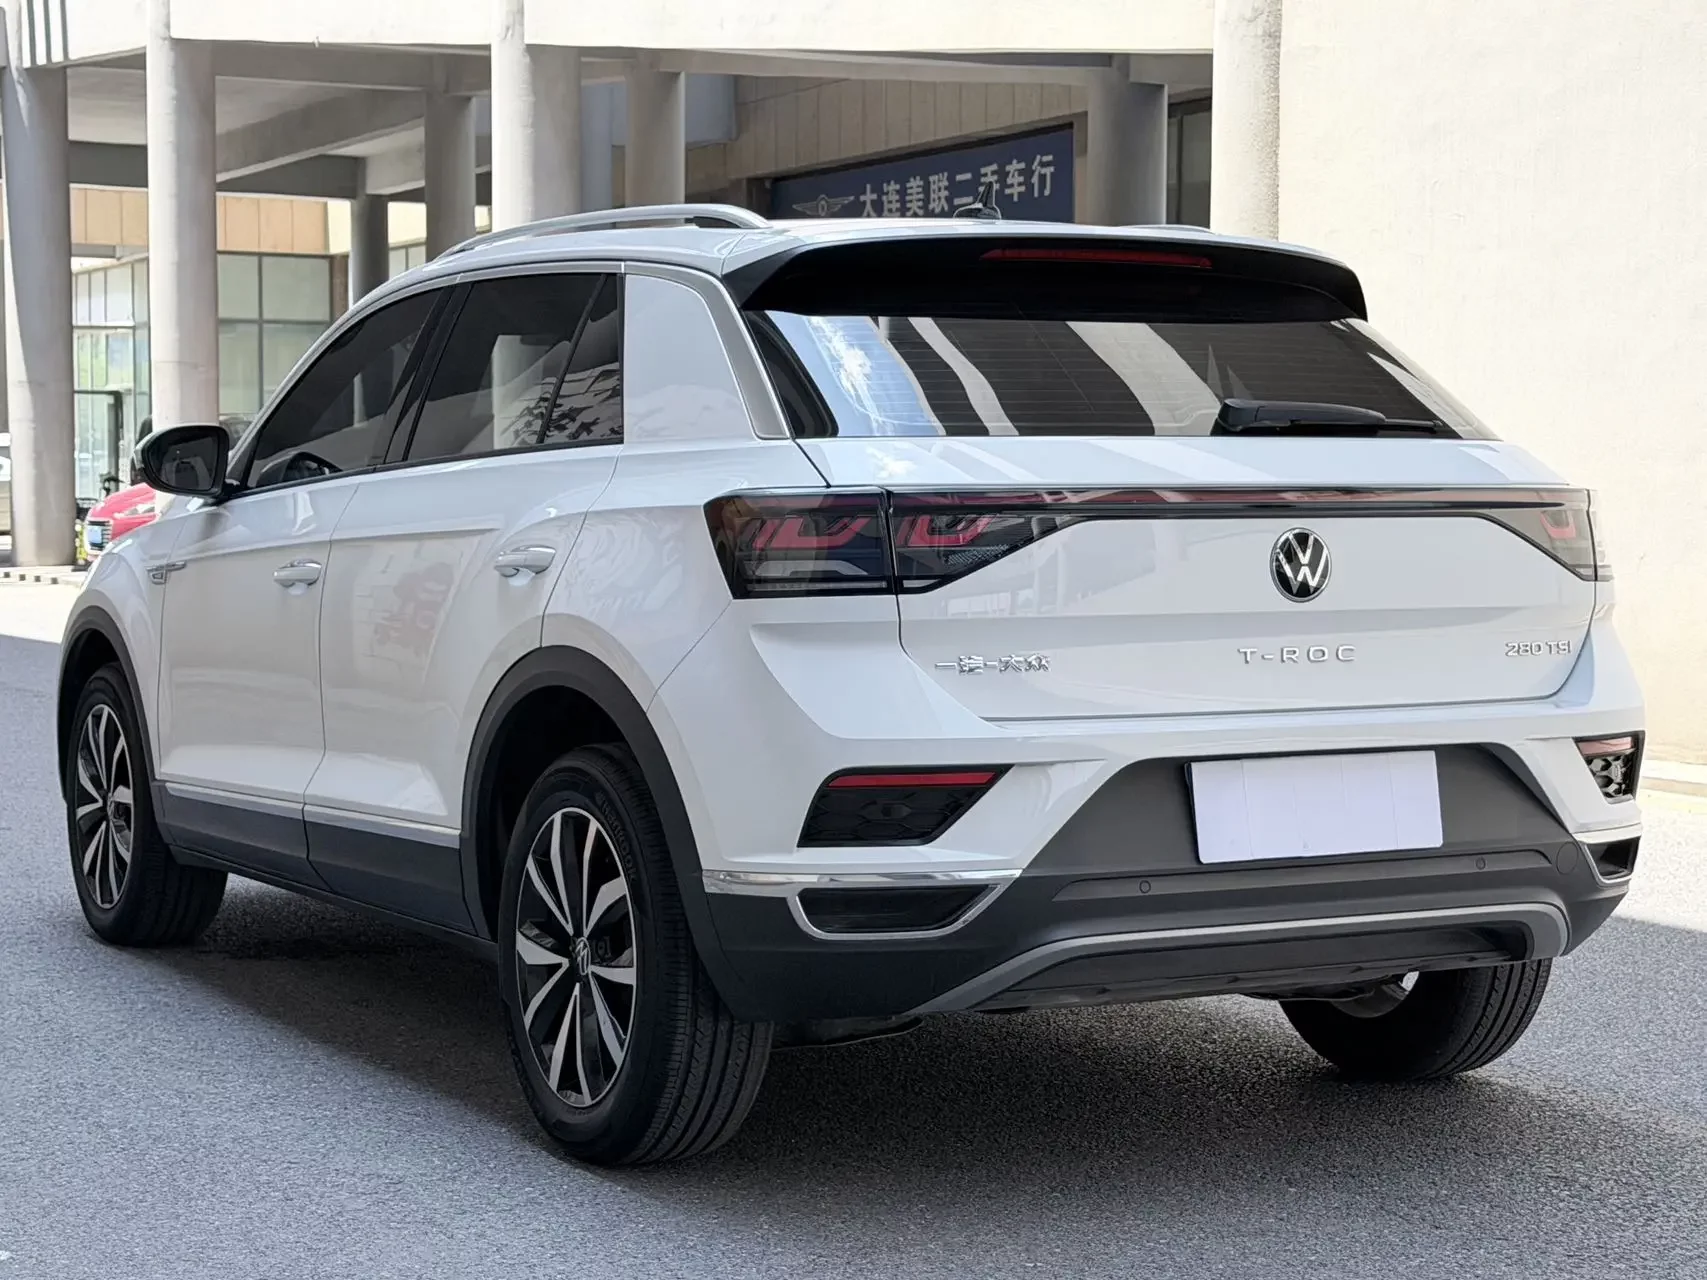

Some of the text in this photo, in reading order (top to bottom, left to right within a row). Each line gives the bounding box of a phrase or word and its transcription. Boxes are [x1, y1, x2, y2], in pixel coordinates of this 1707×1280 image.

[860, 154, 1054, 217] 大连美联二手车行
[1273, 530, 1330, 597] VW
[1237, 644, 1356, 664] T-ROC
[1504, 640, 1572, 657] 280 TSI
